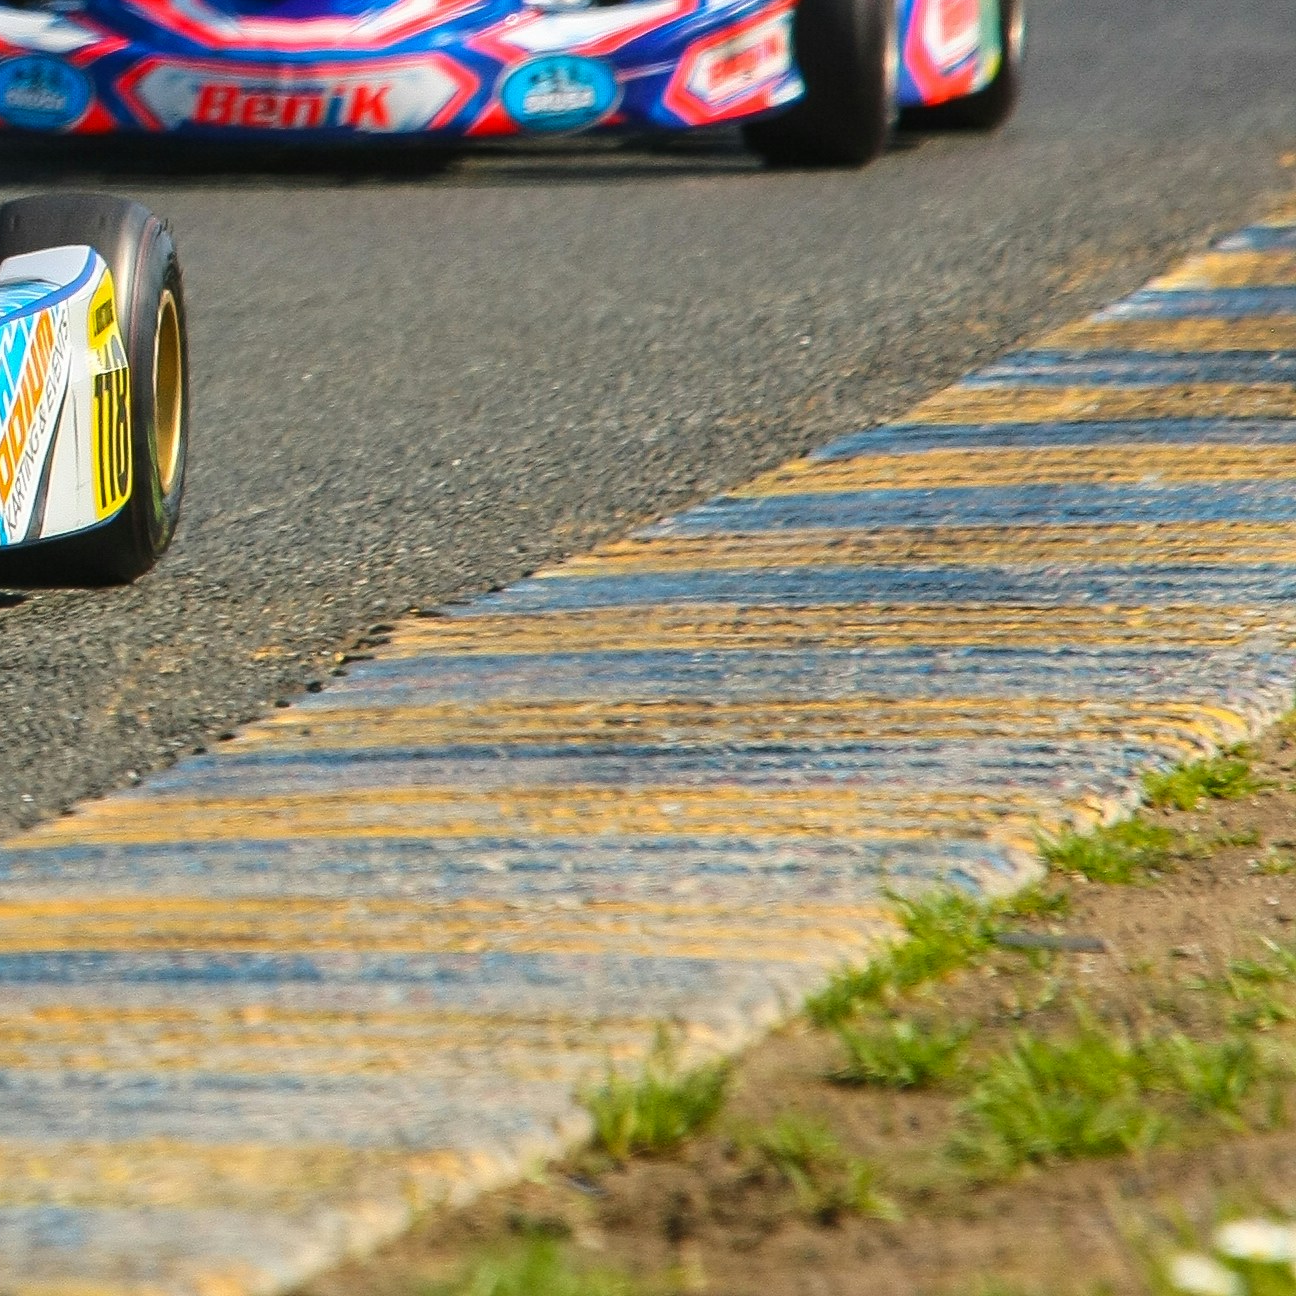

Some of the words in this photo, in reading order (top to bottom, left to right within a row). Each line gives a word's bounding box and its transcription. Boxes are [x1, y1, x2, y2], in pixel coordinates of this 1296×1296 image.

[5, 422, 40, 540] KARTING
[45, 308, 69, 413] EVENTS
[95, 335, 129, 509] 118
